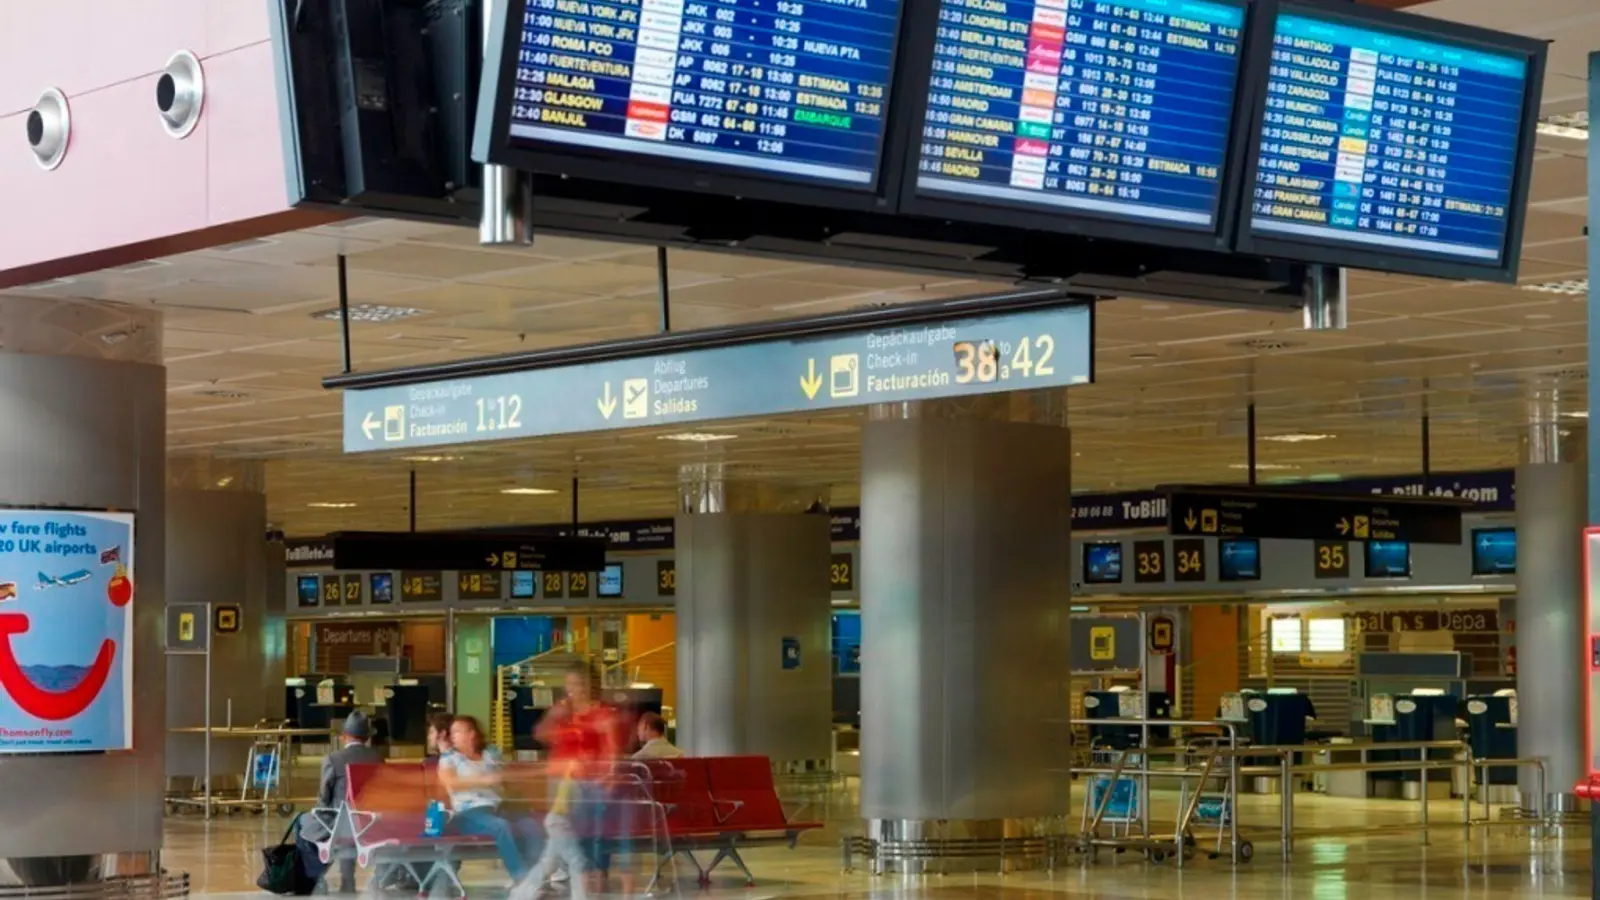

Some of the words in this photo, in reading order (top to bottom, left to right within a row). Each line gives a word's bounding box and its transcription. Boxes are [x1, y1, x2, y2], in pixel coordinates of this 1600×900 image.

[524, 13, 553, 27] 11:00
[554, 16, 587, 34] NUEVA
[588, 22, 615, 38] YORK
[616, 28, 635, 42] JFK
[963, 12, 1008, 32] LONDRES
[1168, 17, 1212, 33] ESTIMADA
[804, 40, 838, 57] NUEVA
[840, 45, 861, 60] PTA
[960, 30, 996, 47] BERLIN
[996, 36, 1027, 52] TEGEL
[1166, 33, 1210, 50] ESTIMADA
[1294, 38, 1334, 54] SANTIAGO
[521, 31, 550, 46] 11:40
[552, 35, 587, 53] ROMA
[588, 41, 614, 56] FCO
[798, 74, 850, 93] ESTIMADA
[956, 63, 994, 79] MADRID
[1292, 53, 1340, 72] VALLADOLID
[518, 50, 548, 65] 11:40
[548, 54, 630, 77] FUERTEVENTURA
[796, 92, 848, 111] ESTIMADA
[1290, 68, 1339, 86] VALLADOLID
[952, 80, 1012, 98] AMSTERDAM
[1287, 84, 1330, 101] ZARAGOZA
[514, 87, 543, 102] 12:30
[544, 91, 604, 111] GLASGOW
[516, 69, 544, 82] 12:25
[546, 72, 596, 91] MALAGA
[793, 108, 853, 128] EMBARQUE
[952, 96, 990, 112] MADRID
[512, 106, 540, 120] 12:40
[541, 109, 587, 128] BANJUL
[949, 113, 974, 127] GRAN
[975, 116, 1014, 132] CANARIA
[1306, 118, 1338, 132] CANARIA
[944, 146, 984, 162] SEVILLA
[947, 130, 1000, 147] HANNOVER
[1148, 158, 1191, 175] ESTIMADA
[942, 163, 980, 178] MADRID
[1278, 160, 1300, 172] FARO
[1274, 190, 1322, 206] FRANKFURT
[1272, 206, 1294, 218] GRAN
[1294, 208, 1326, 222] CANARIA
[866, 326, 956, 350] Gepäckaufgabe
[654, 360, 686, 376] Abflug
[867, 351, 918, 370] Check-in
[867, 368, 950, 392] Facturación
[953, 341, 998, 384] 38
[1001, 364, 1010, 380] a
[1012, 334, 1054, 378] 42
[654, 376, 709, 396] Departures
[410, 404, 446, 420] Check-in
[410, 418, 468, 438] Facturación
[476, 398, 487, 432] 1
[488, 418, 496, 432] a
[497, 394, 522, 430] 12
[654, 398, 698, 416] Salidas
[12, 521, 40, 534] fare
[44, 522, 87, 538] flights
[0, 540, 14, 552] 20
[19, 540, 41, 552] UK
[44, 541, 97, 556] airports
[1138, 552, 1161, 574] 33
[1178, 551, 1201, 573] 34
[1319, 546, 1345, 569] 35
[546, 573, 561, 591] 28
[571, 572, 586, 590] 29
[660, 570, 676, 588] 30
[830, 564, 848, 584] 32
[325, 583, 338, 600] 26
[346, 582, 360, 598] 27
[323, 629, 372, 645] Departures
